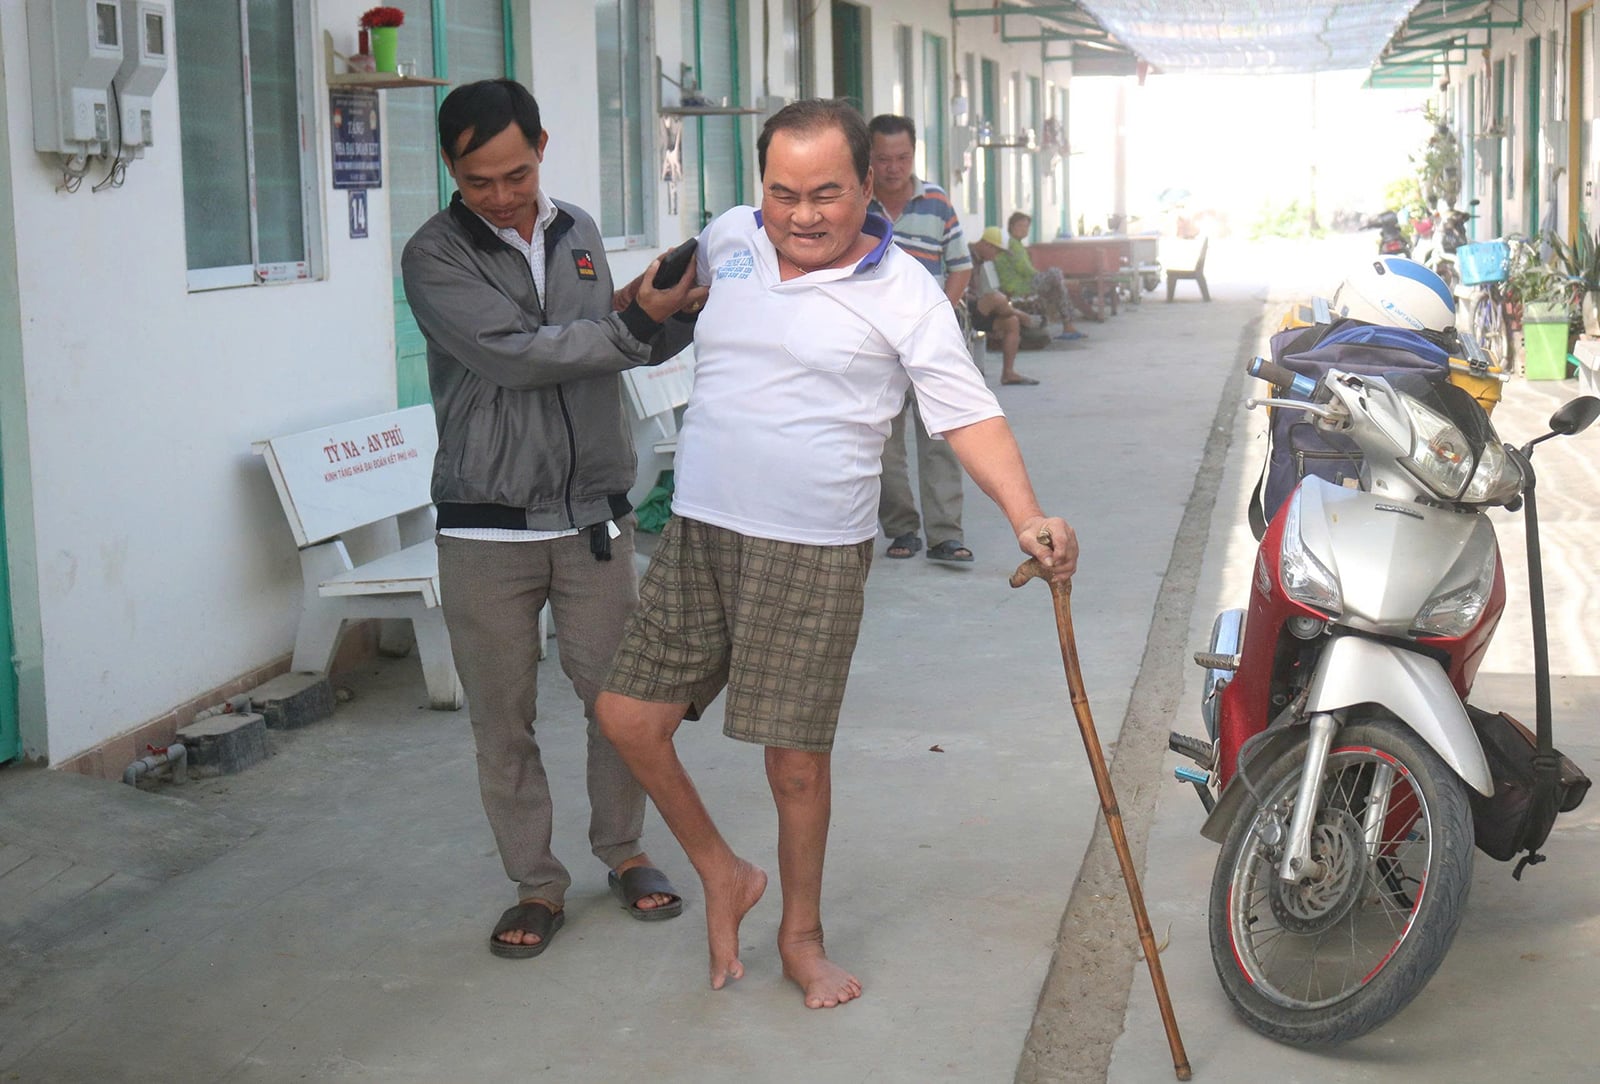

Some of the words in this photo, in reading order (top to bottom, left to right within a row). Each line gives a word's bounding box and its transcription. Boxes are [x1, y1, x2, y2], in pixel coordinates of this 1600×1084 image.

[351, 198, 365, 230] 14
[341, 440, 361, 459] NA
[367, 433, 383, 453] AN
